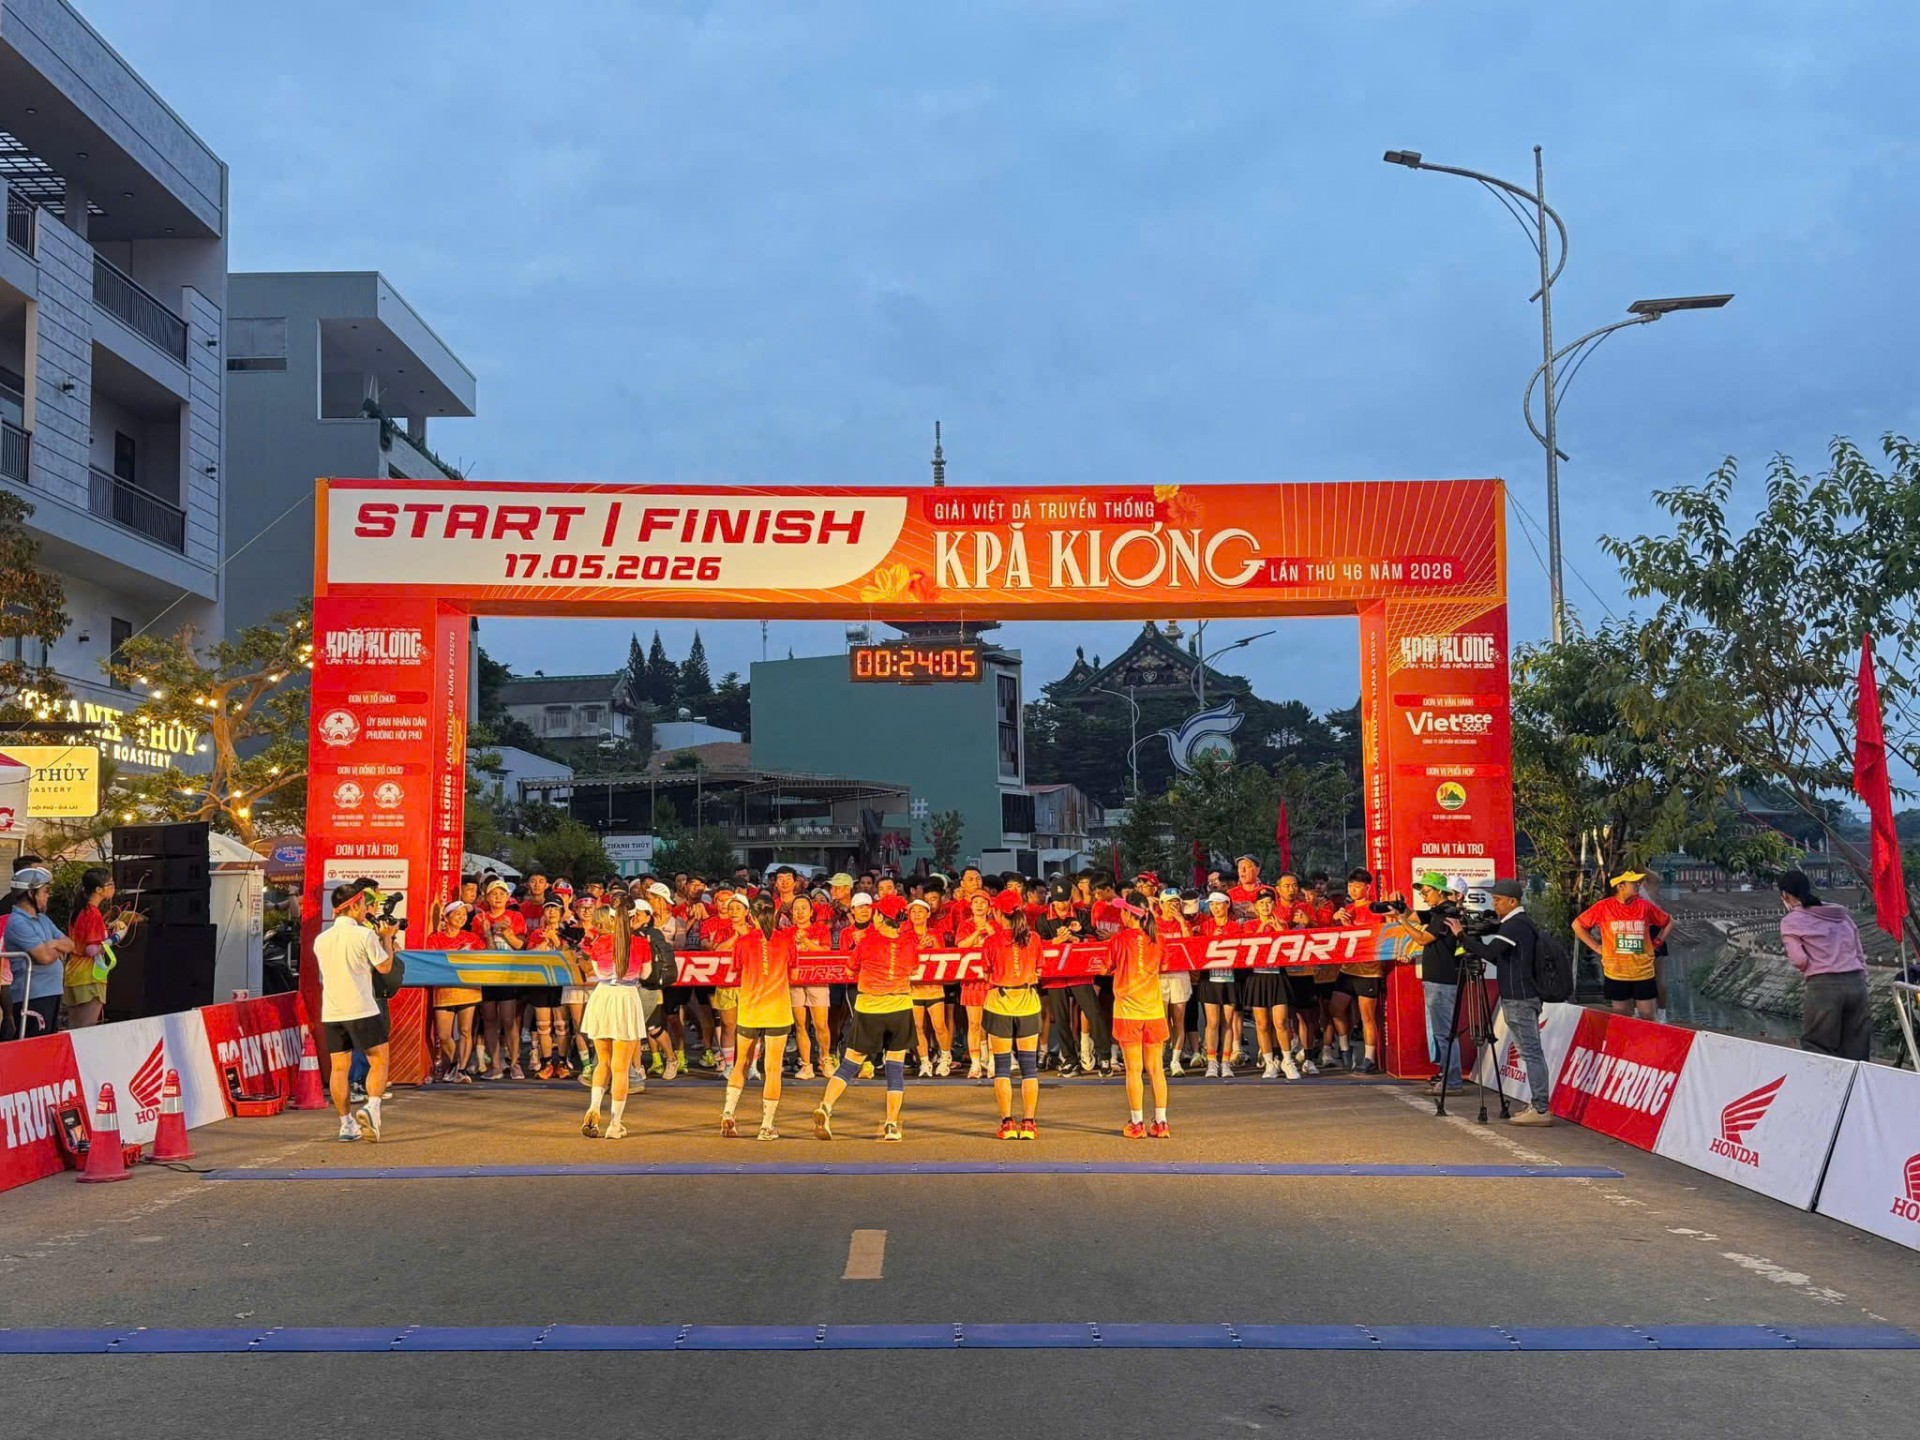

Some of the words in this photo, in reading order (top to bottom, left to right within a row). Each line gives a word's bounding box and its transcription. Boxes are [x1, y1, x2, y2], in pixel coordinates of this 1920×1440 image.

[935, 499, 965, 519] GIẢI
[972, 499, 1005, 522] VIỆT
[1012, 500, 1032, 519] DÃ
[1039, 497, 1097, 519] TRUYỀN
[1103, 498, 1155, 518] THỐNG
[354, 503, 586, 540] START
[638, 508, 866, 545] FINISH
[504, 553, 722, 581] 17.05.2026
[931, 522, 1034, 590] KPĂ
[1048, 522, 1266, 590] KLƠNG
[1270, 559, 1298, 582] LẦN
[1306, 560, 1336, 581] THỨ
[1342, 563, 1363, 580] 46
[1370, 560, 1403, 580] NĂM
[1410, 562, 1452, 580] 2026
[857, 650, 976, 676] 00:24:05
[113, 744, 172, 769] ROASTERY
[35, 762, 89, 782] THỦY
[335, 843, 354, 856] ĐƠN
[355, 843, 365, 857] VỊ
[366, 842, 380, 856] TÀI
[382, 843, 399, 858] TRỢ
[1422, 842, 1440, 855] ĐƠN
[1441, 842, 1450, 856] VỊ
[1452, 840, 1466, 855] TÀI
[1467, 841, 1484, 857] TRỢ
[1202, 929, 1372, 969] START
[1618, 939, 1642, 949] 51251
[1500, 1064, 1527, 1083] HONDA
[1561, 1040, 1617, 1097] TOÀN
[1603, 1058, 1677, 1116] TRUNG
[1709, 1137, 1760, 1168] HONDA
[1889, 1196, 1920, 1224] HO
